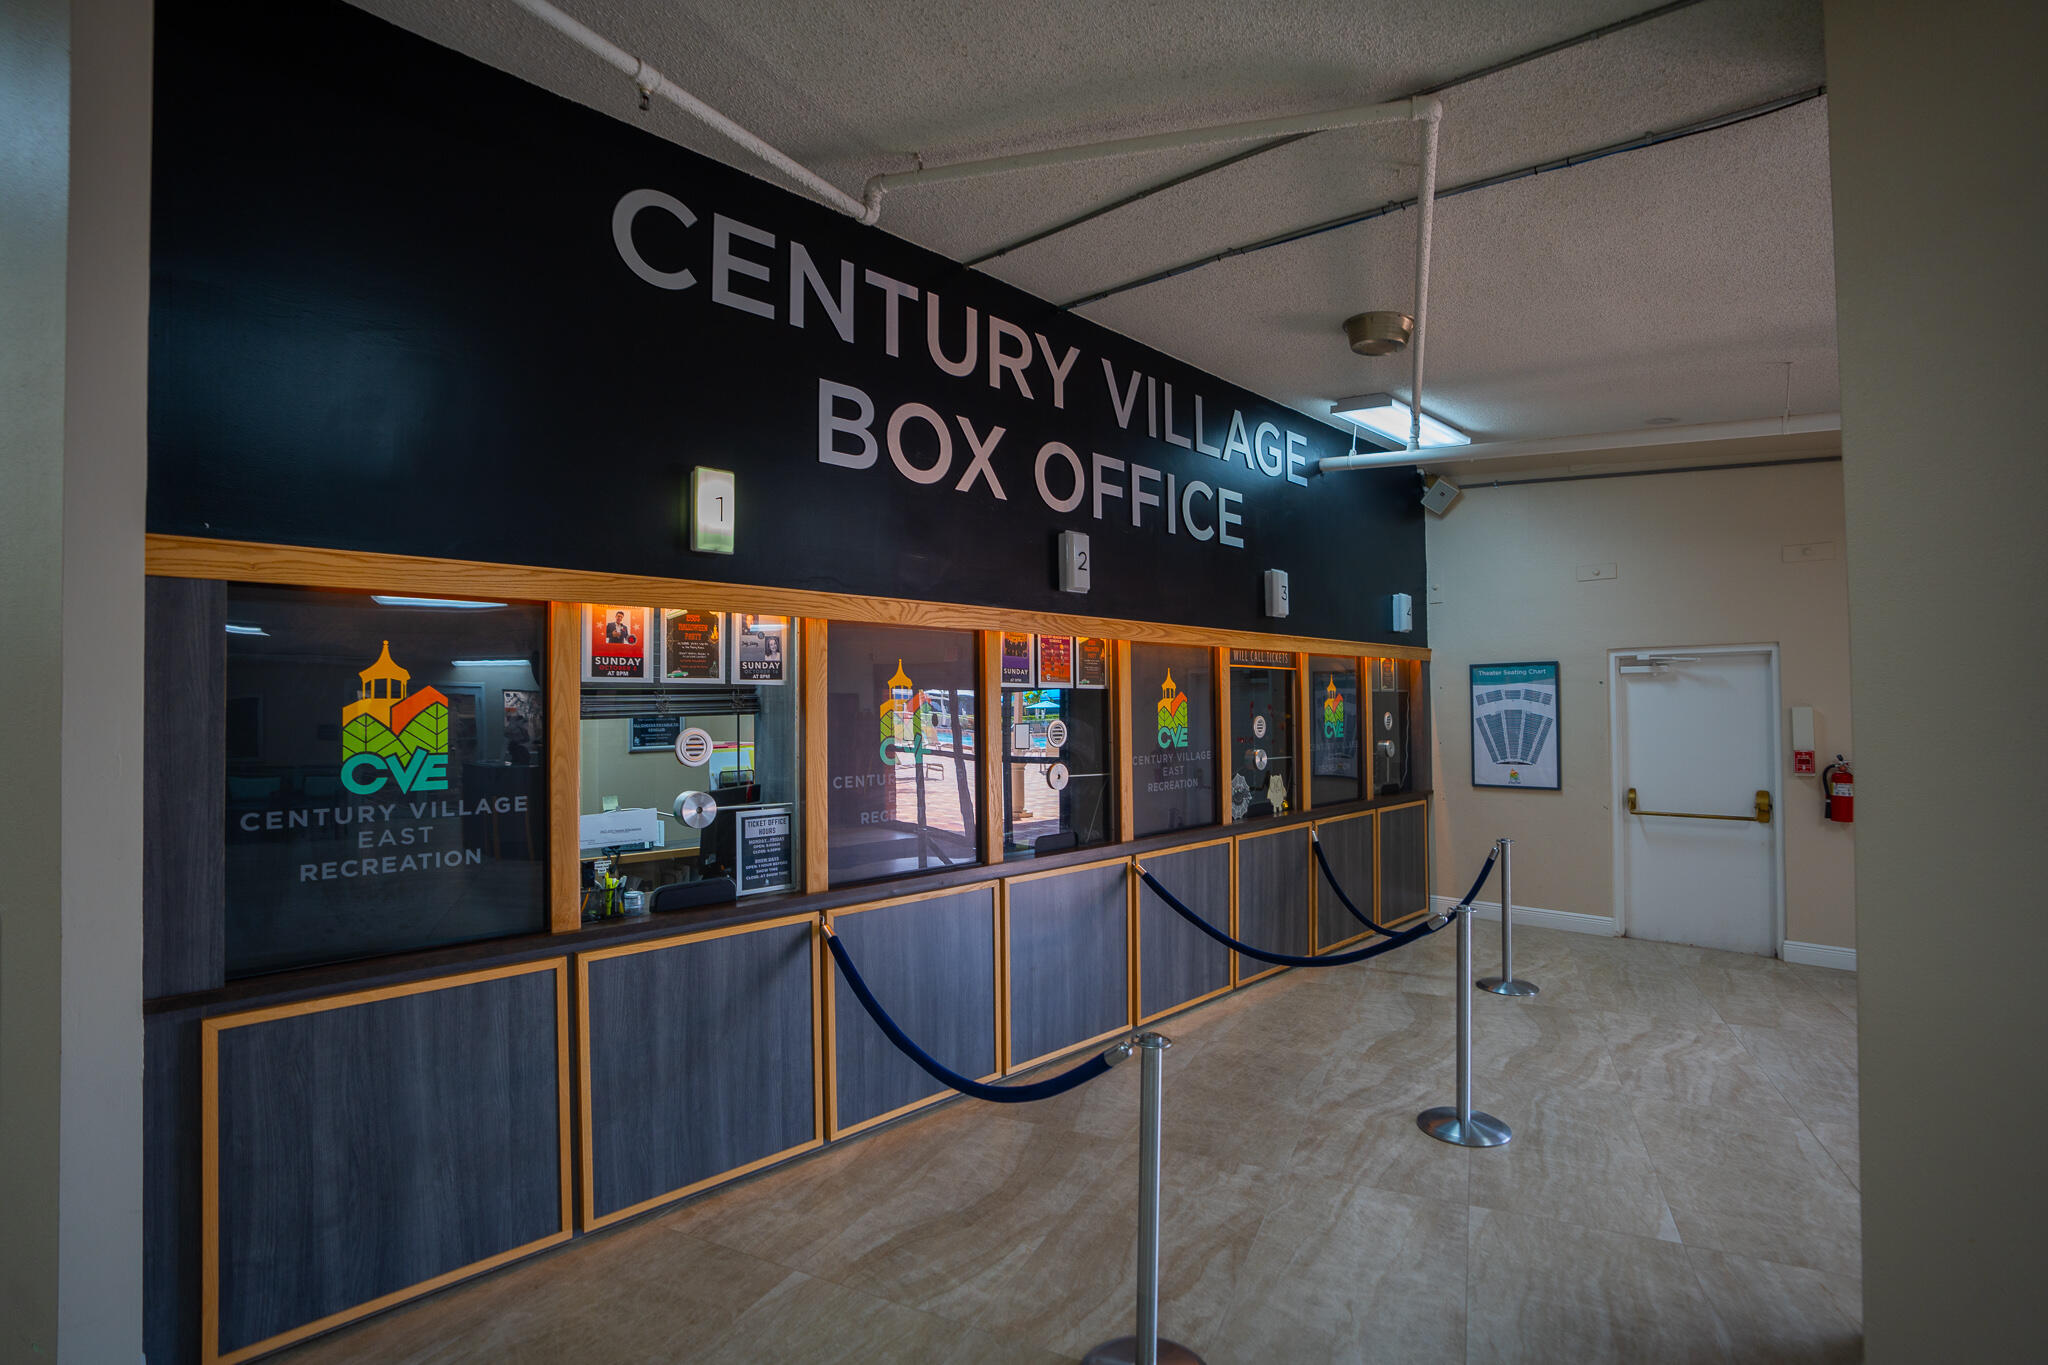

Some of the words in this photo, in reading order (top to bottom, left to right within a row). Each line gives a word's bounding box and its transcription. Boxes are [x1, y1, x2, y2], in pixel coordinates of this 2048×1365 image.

[612, 188, 1080, 409] CENTURY
[1101, 358, 1309, 487] VILLAGE
[818, 378, 1008, 501] BOX
[1034, 441, 1244, 549] OFFICE
[714, 496, 724, 522] 1
[1078, 551, 1088, 571] 2
[1281, 585, 1288, 601] 3
[595, 656, 641, 666] SUNDAY
[742, 661, 780, 669] SUNDAY
[1233, 649, 1248, 662] WILL
[1250, 650, 1264, 663] CALL
[1266, 651, 1288, 665] TICKETS
[1158, 725, 1189, 749] CVE
[1324, 719, 1344, 738] CVE
[1132, 752, 1174, 765] CENTURY
[1177, 750, 1211, 761] VILLAGE
[341, 746, 449, 795] CVE
[1163, 766, 1184, 776] EAST
[1148, 778, 1198, 792] RECREATION
[240, 804, 397, 832] CENTURY
[409, 796, 528, 819] VILLAGE
[747, 820, 766, 828] TICKET
[768, 818, 787, 826] OFFICE
[358, 826, 434, 849] EAST
[758, 827, 776, 835] HOURS
[300, 848, 482, 882] RECREATION
